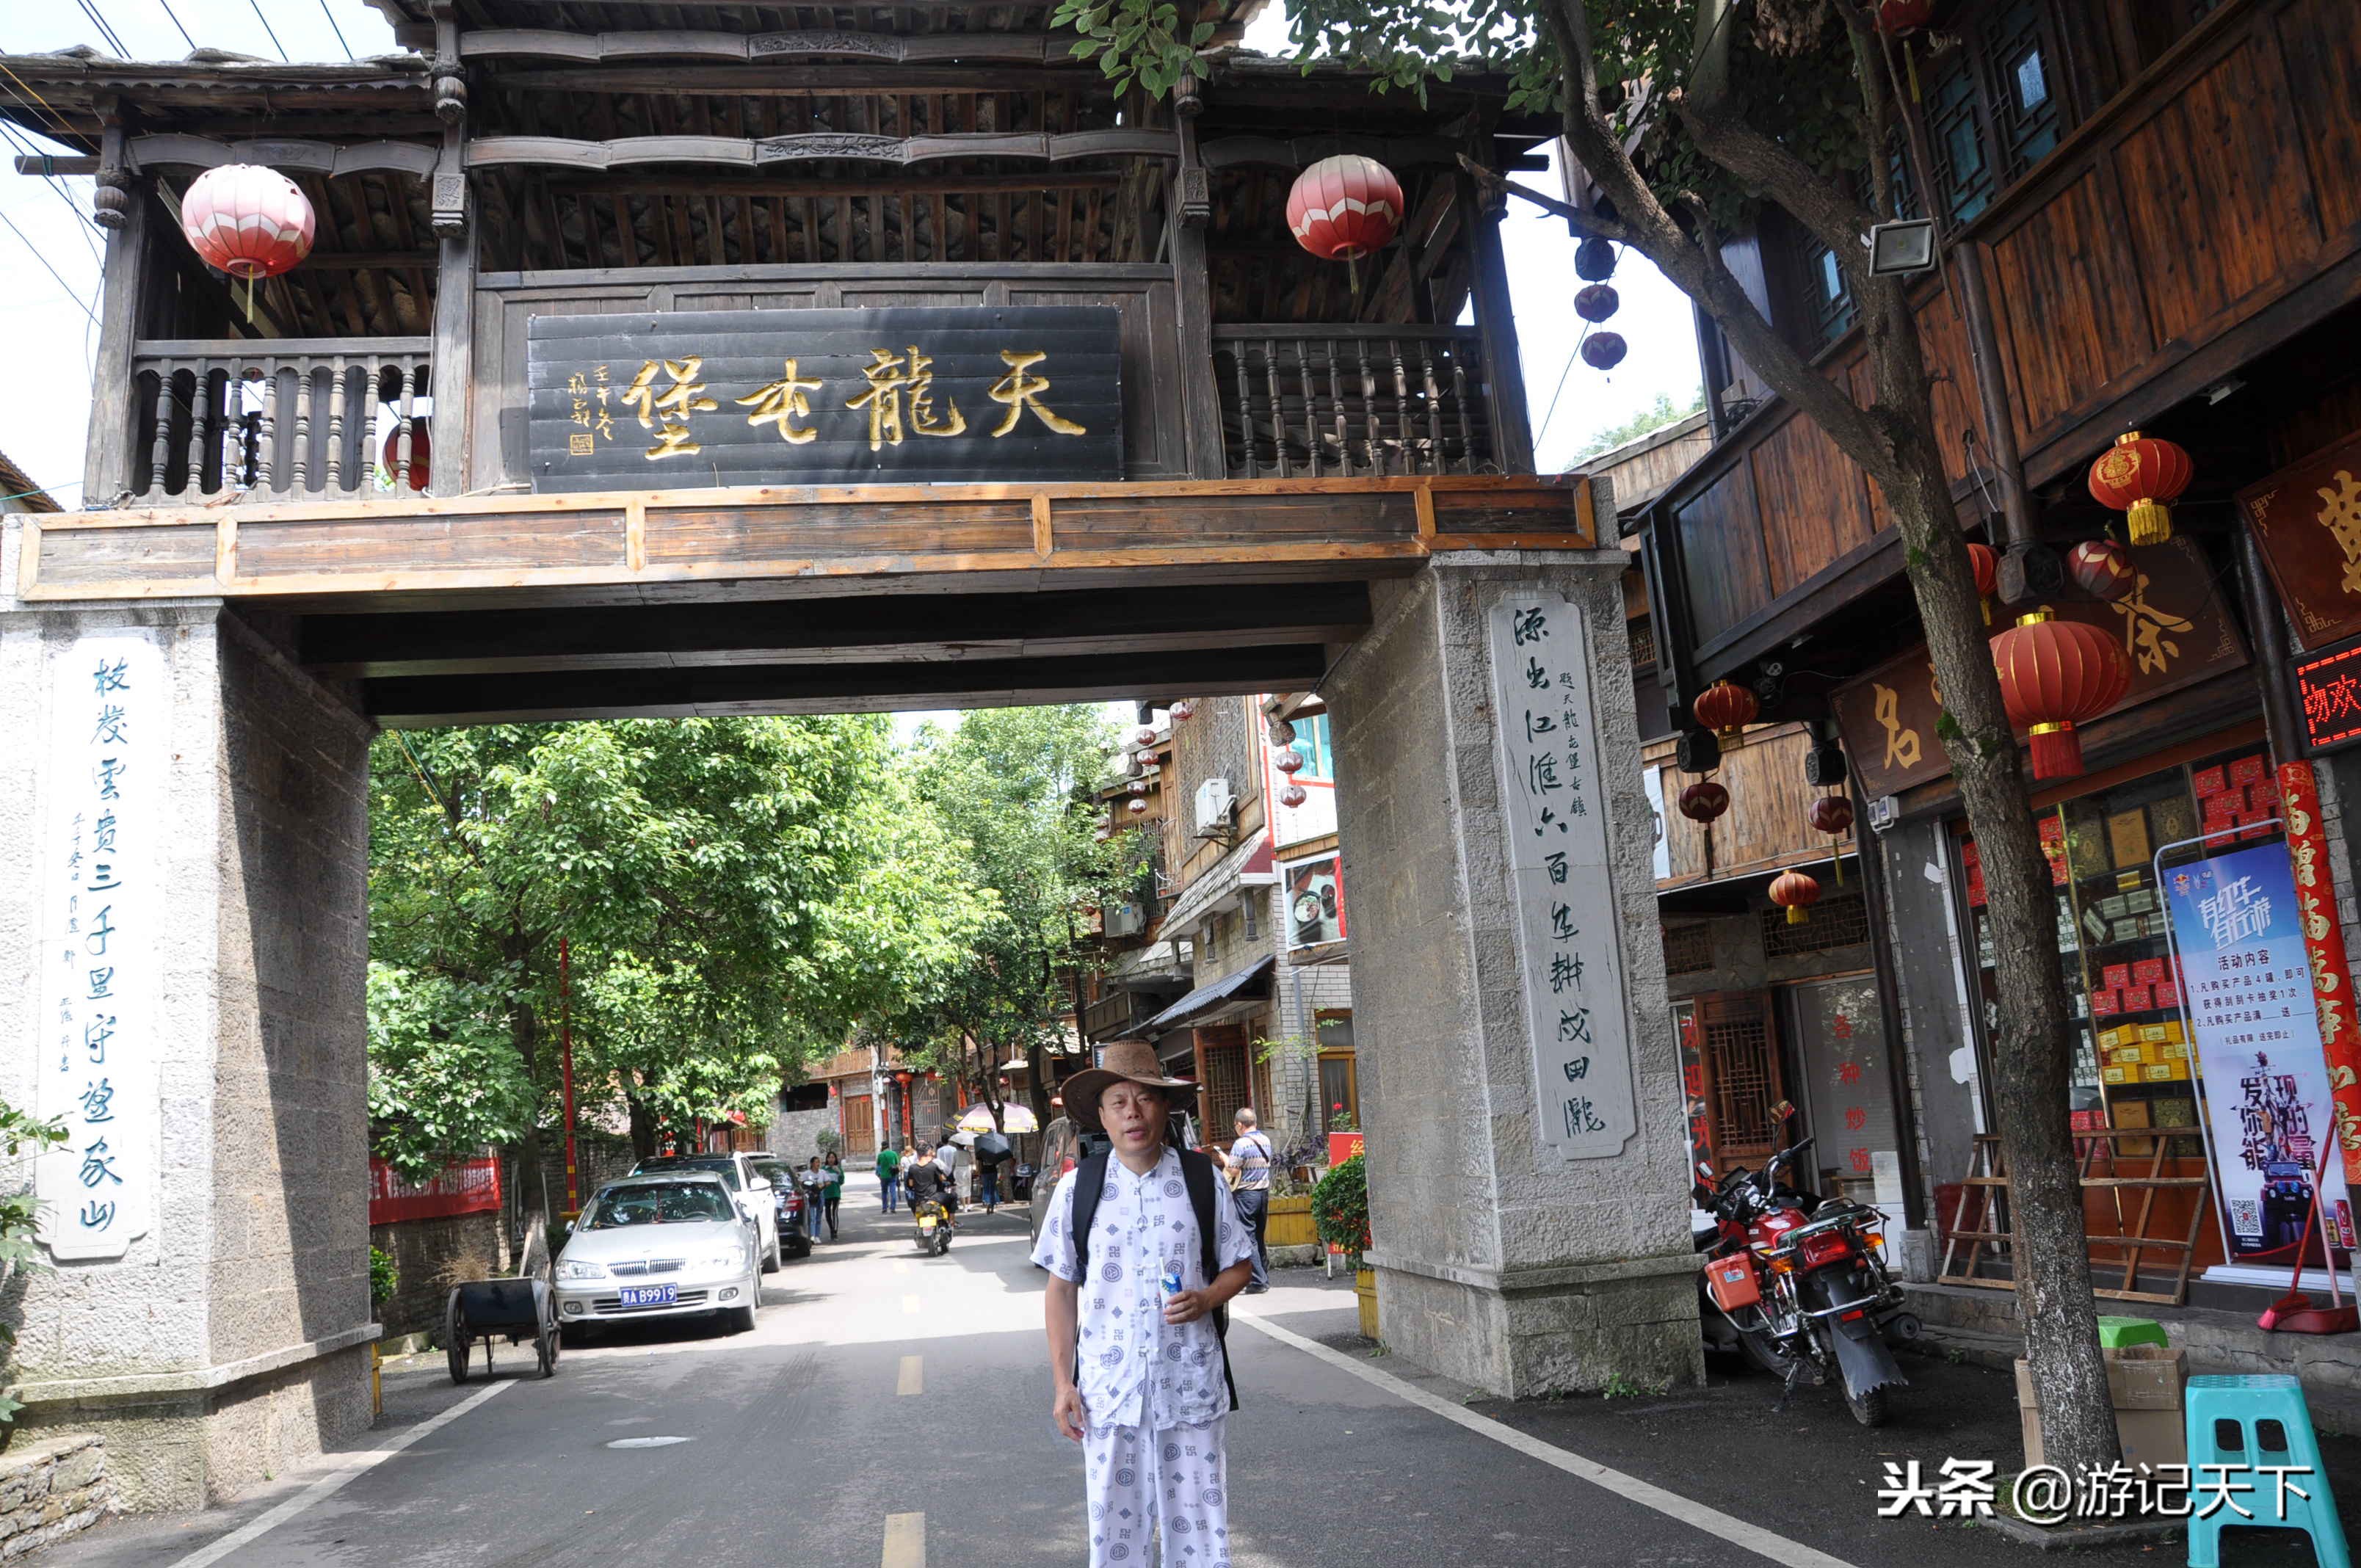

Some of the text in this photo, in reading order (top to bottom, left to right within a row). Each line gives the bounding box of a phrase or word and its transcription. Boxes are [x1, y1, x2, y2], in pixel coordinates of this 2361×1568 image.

[2218, 949, 2270, 970] 活动内容
[1833, 1015, 1871, 1172] 各种炒饭
